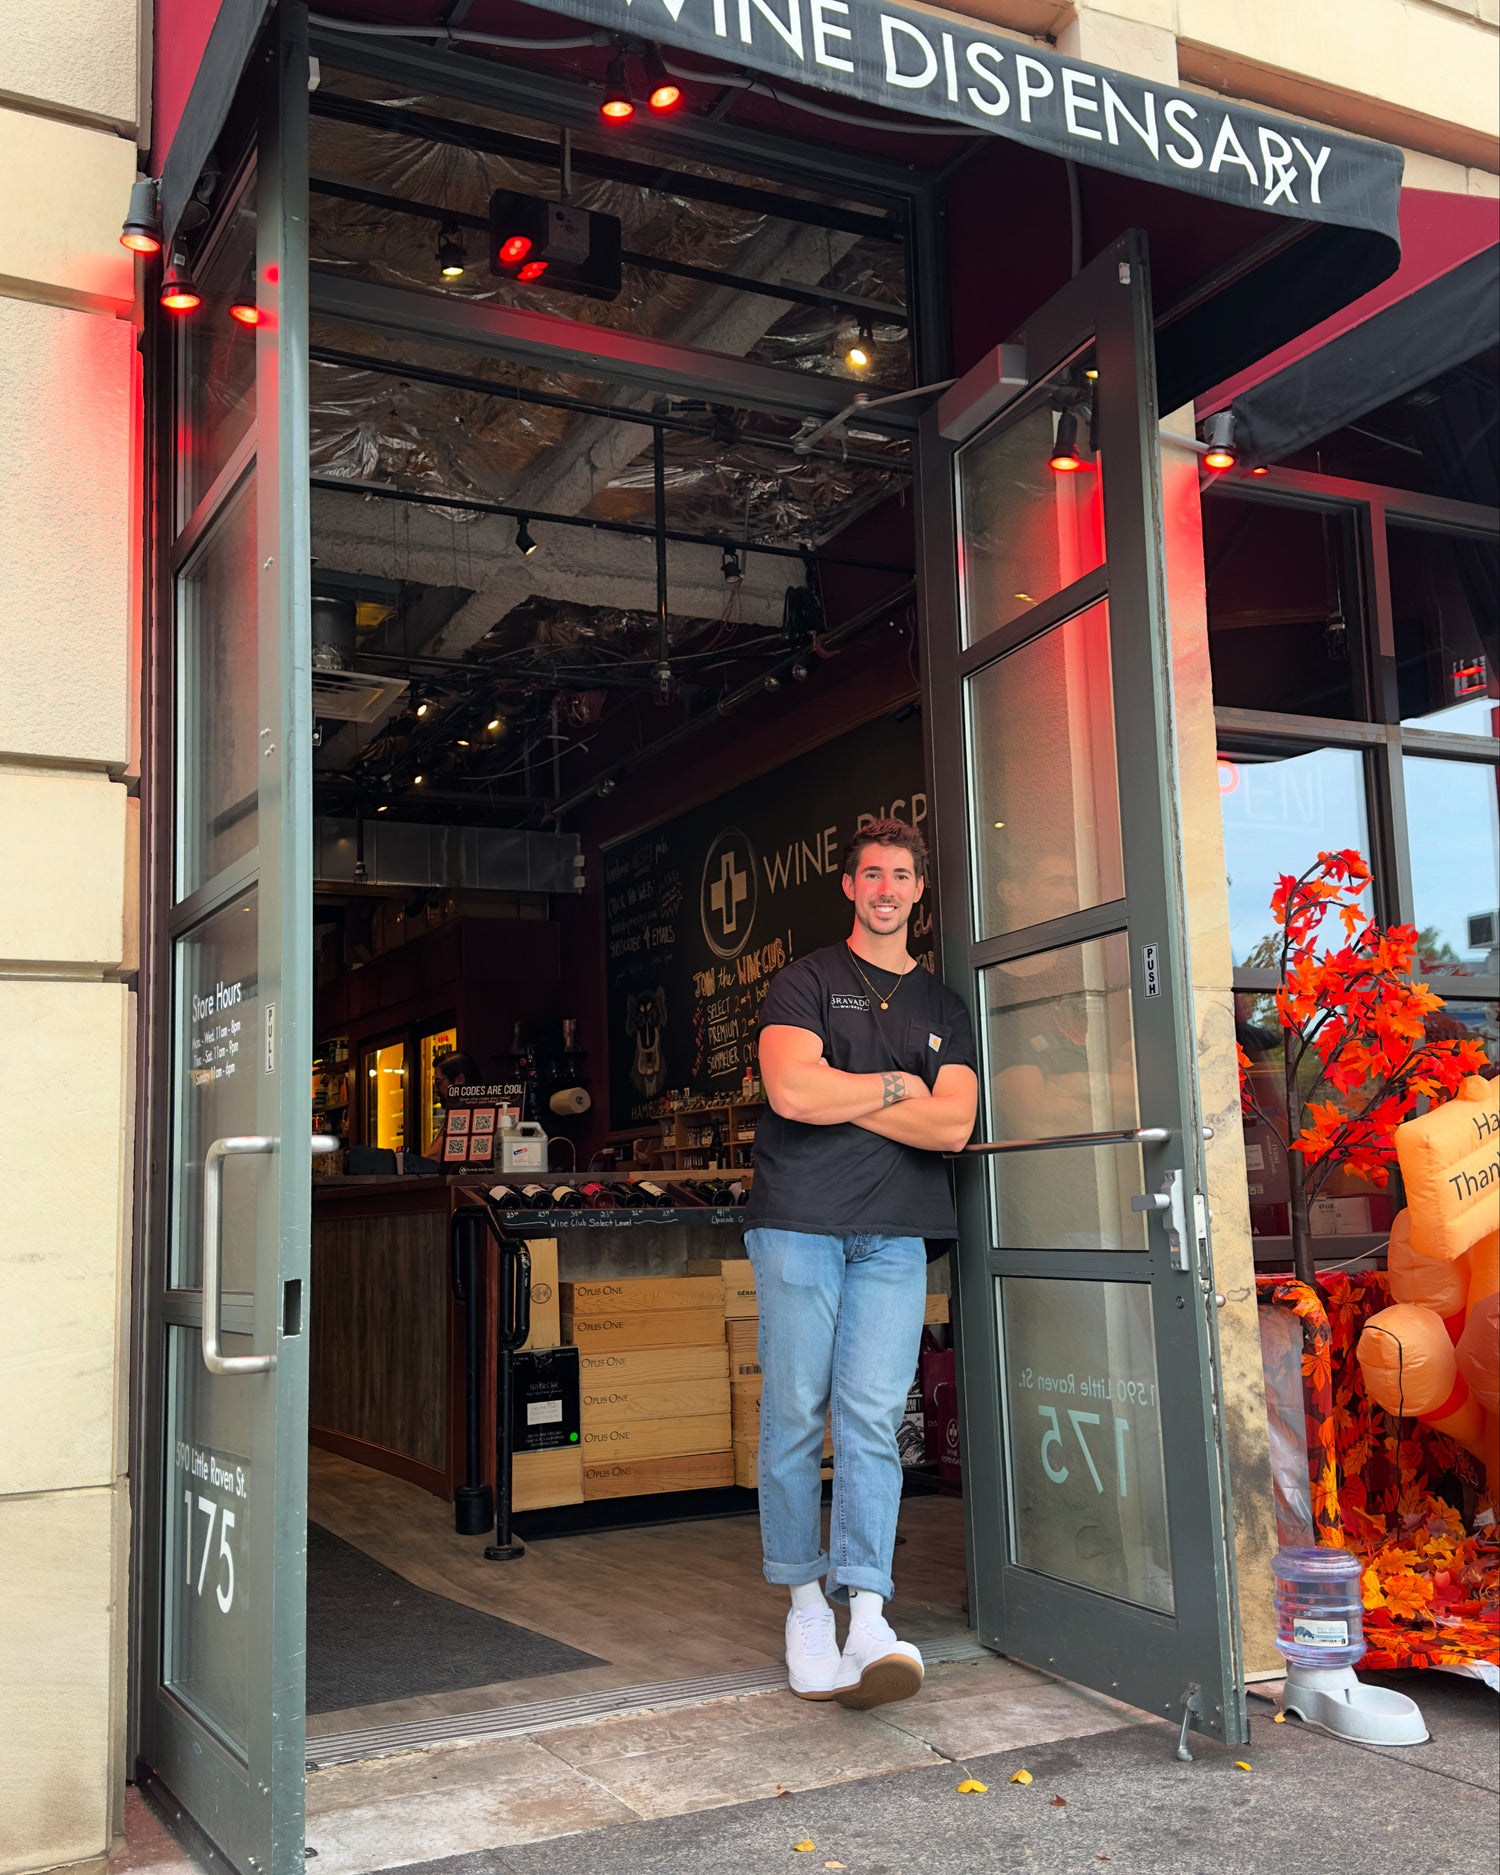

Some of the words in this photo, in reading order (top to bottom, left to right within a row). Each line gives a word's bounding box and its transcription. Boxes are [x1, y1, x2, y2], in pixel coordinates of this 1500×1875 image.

[624, 0, 855, 73] INE
[763, 826, 839, 894] WINE
[692, 967, 716, 998] JOIN
[717, 966, 736, 988] the
[1147, 948, 1156, 995] PUSH
[192, 994, 214, 1023] Store
[216, 980, 242, 1012] Hours
[707, 996, 731, 1022] SELECT
[831, 997, 870, 1007] BRAVADO
[707, 1018, 740, 1046] PREMIUM
[707, 1046, 741, 1074] SOMMELIER
[449, 1086, 460, 1097] QR
[460, 1085, 486, 1097] CODES
[486, 1085, 502, 1095] ARE
[503, 1083, 524, 1094] COOL
[1449, 1151, 1500, 1201] Than
[549, 1219, 568, 1228] Wine
[570, 1218, 586, 1227] Club
[589, 1218, 614, 1227] Select
[614, 1218, 632, 1227] Level
[191, 1448, 208, 1481] Little
[210, 1456, 234, 1493] Raven
[235, 1466, 247, 1499] St.
[184, 1489, 235, 1614] 175
